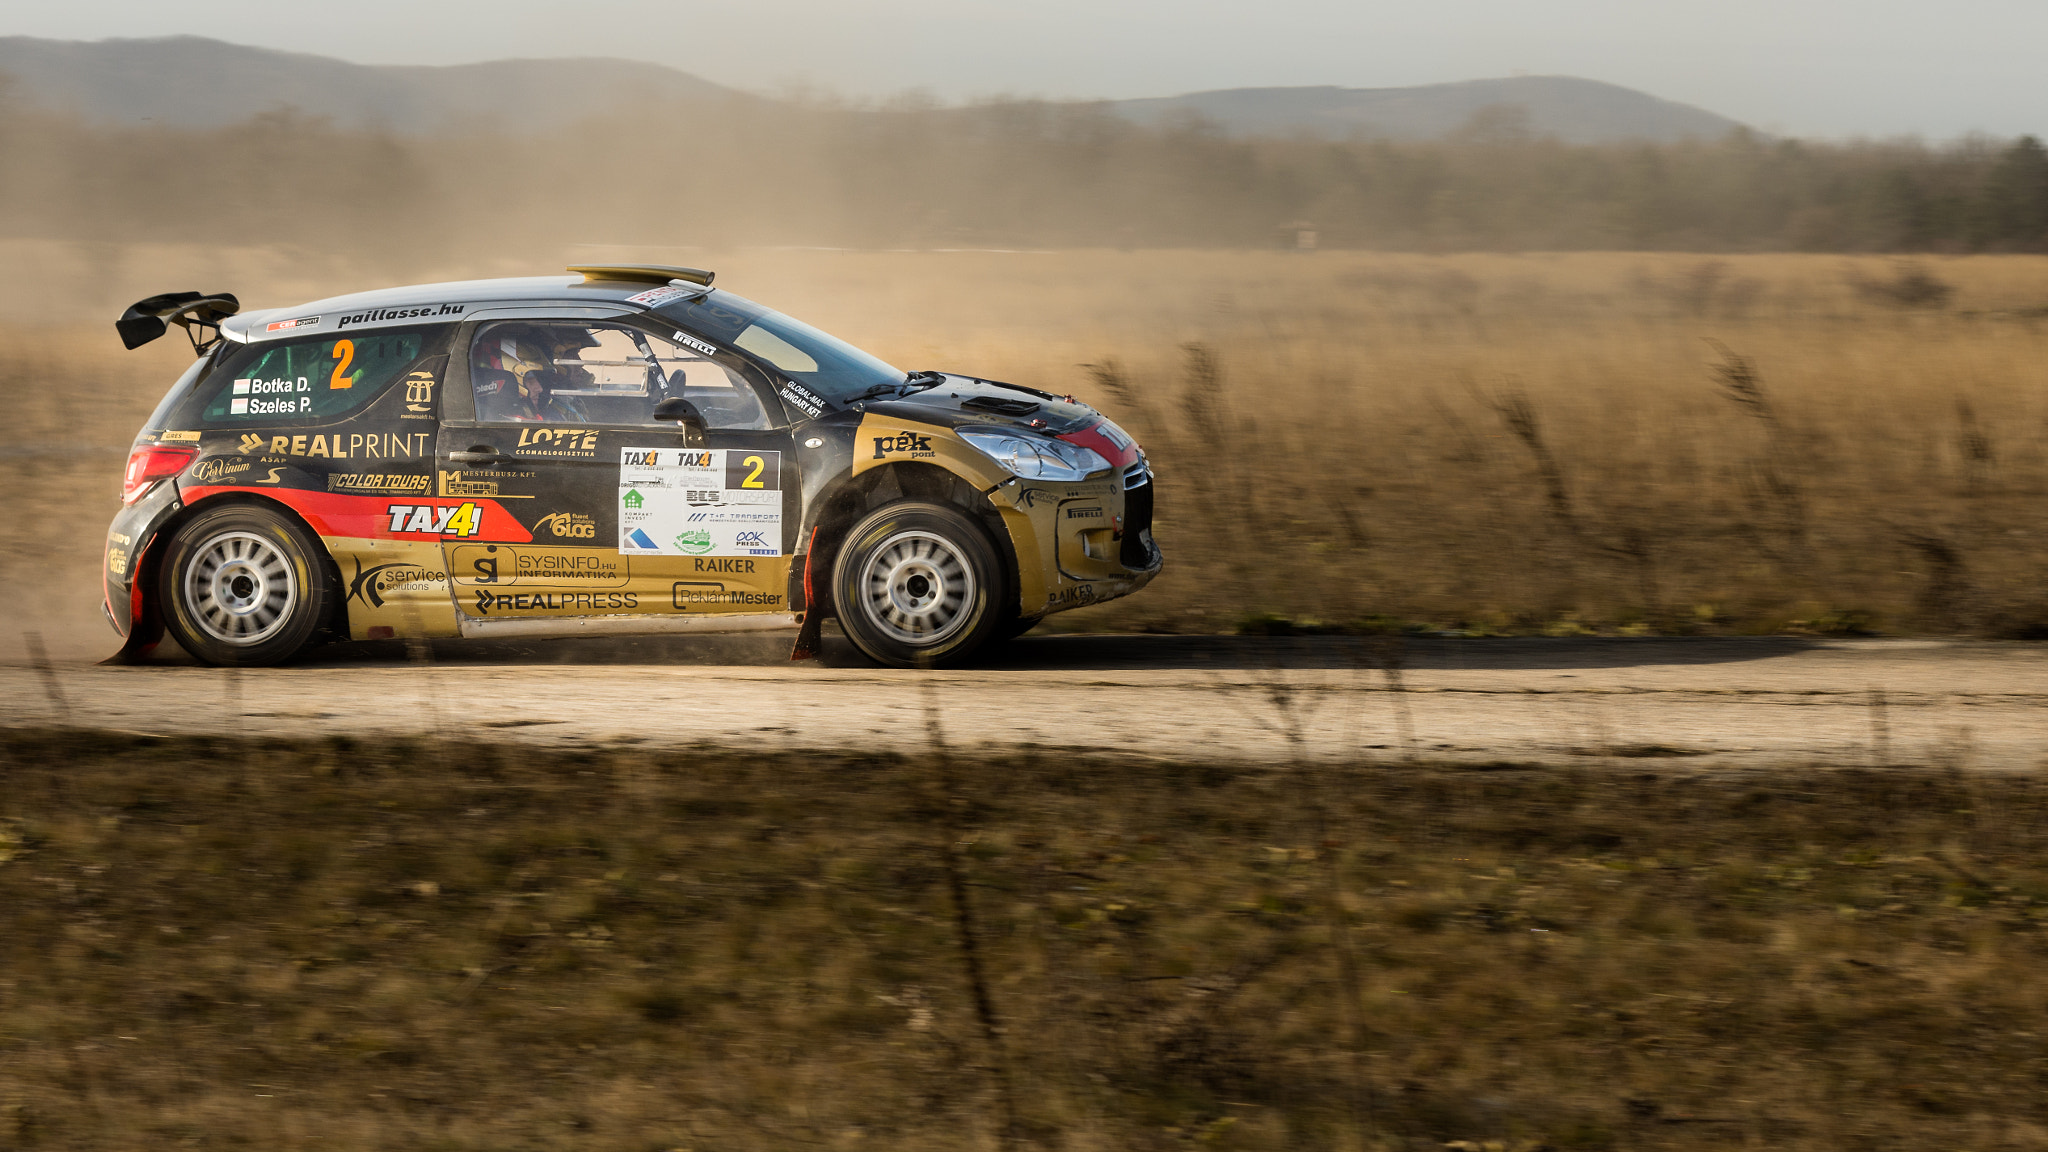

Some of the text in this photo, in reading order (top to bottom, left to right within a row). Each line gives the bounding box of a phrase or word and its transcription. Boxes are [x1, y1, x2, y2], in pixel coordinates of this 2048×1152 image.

[338, 304, 464, 328] paillasse.hu
[673, 330, 717, 356] PIRELLI
[330, 339, 354, 390] 2
[251, 377, 311, 395] Botka D.
[787, 380, 826, 408] GLOBAL-MAX
[250, 397, 311, 414] Szeles P.
[780, 387, 822, 418] HUNGARY KFT
[269, 433, 429, 459] REALPRINT
[515, 449, 595, 458] CSOMAGLOGISZTIKA
[873, 431, 931, 459] pék
[260, 456, 288, 464] ASAP
[912, 451, 936, 459] pont
[741, 455, 765, 489] 2
[335, 473, 430, 490] COLOR TOURS
[1067, 507, 1103, 518] PIRELLI
[695, 558, 756, 574] RAIKER
[385, 568, 445, 582] service
[519, 570, 617, 580] INFORMATIKA
[386, 581, 430, 591] solutions
[496, 592, 639, 610] REALPRESS
[681, 588, 783, 605] ReklámMester
